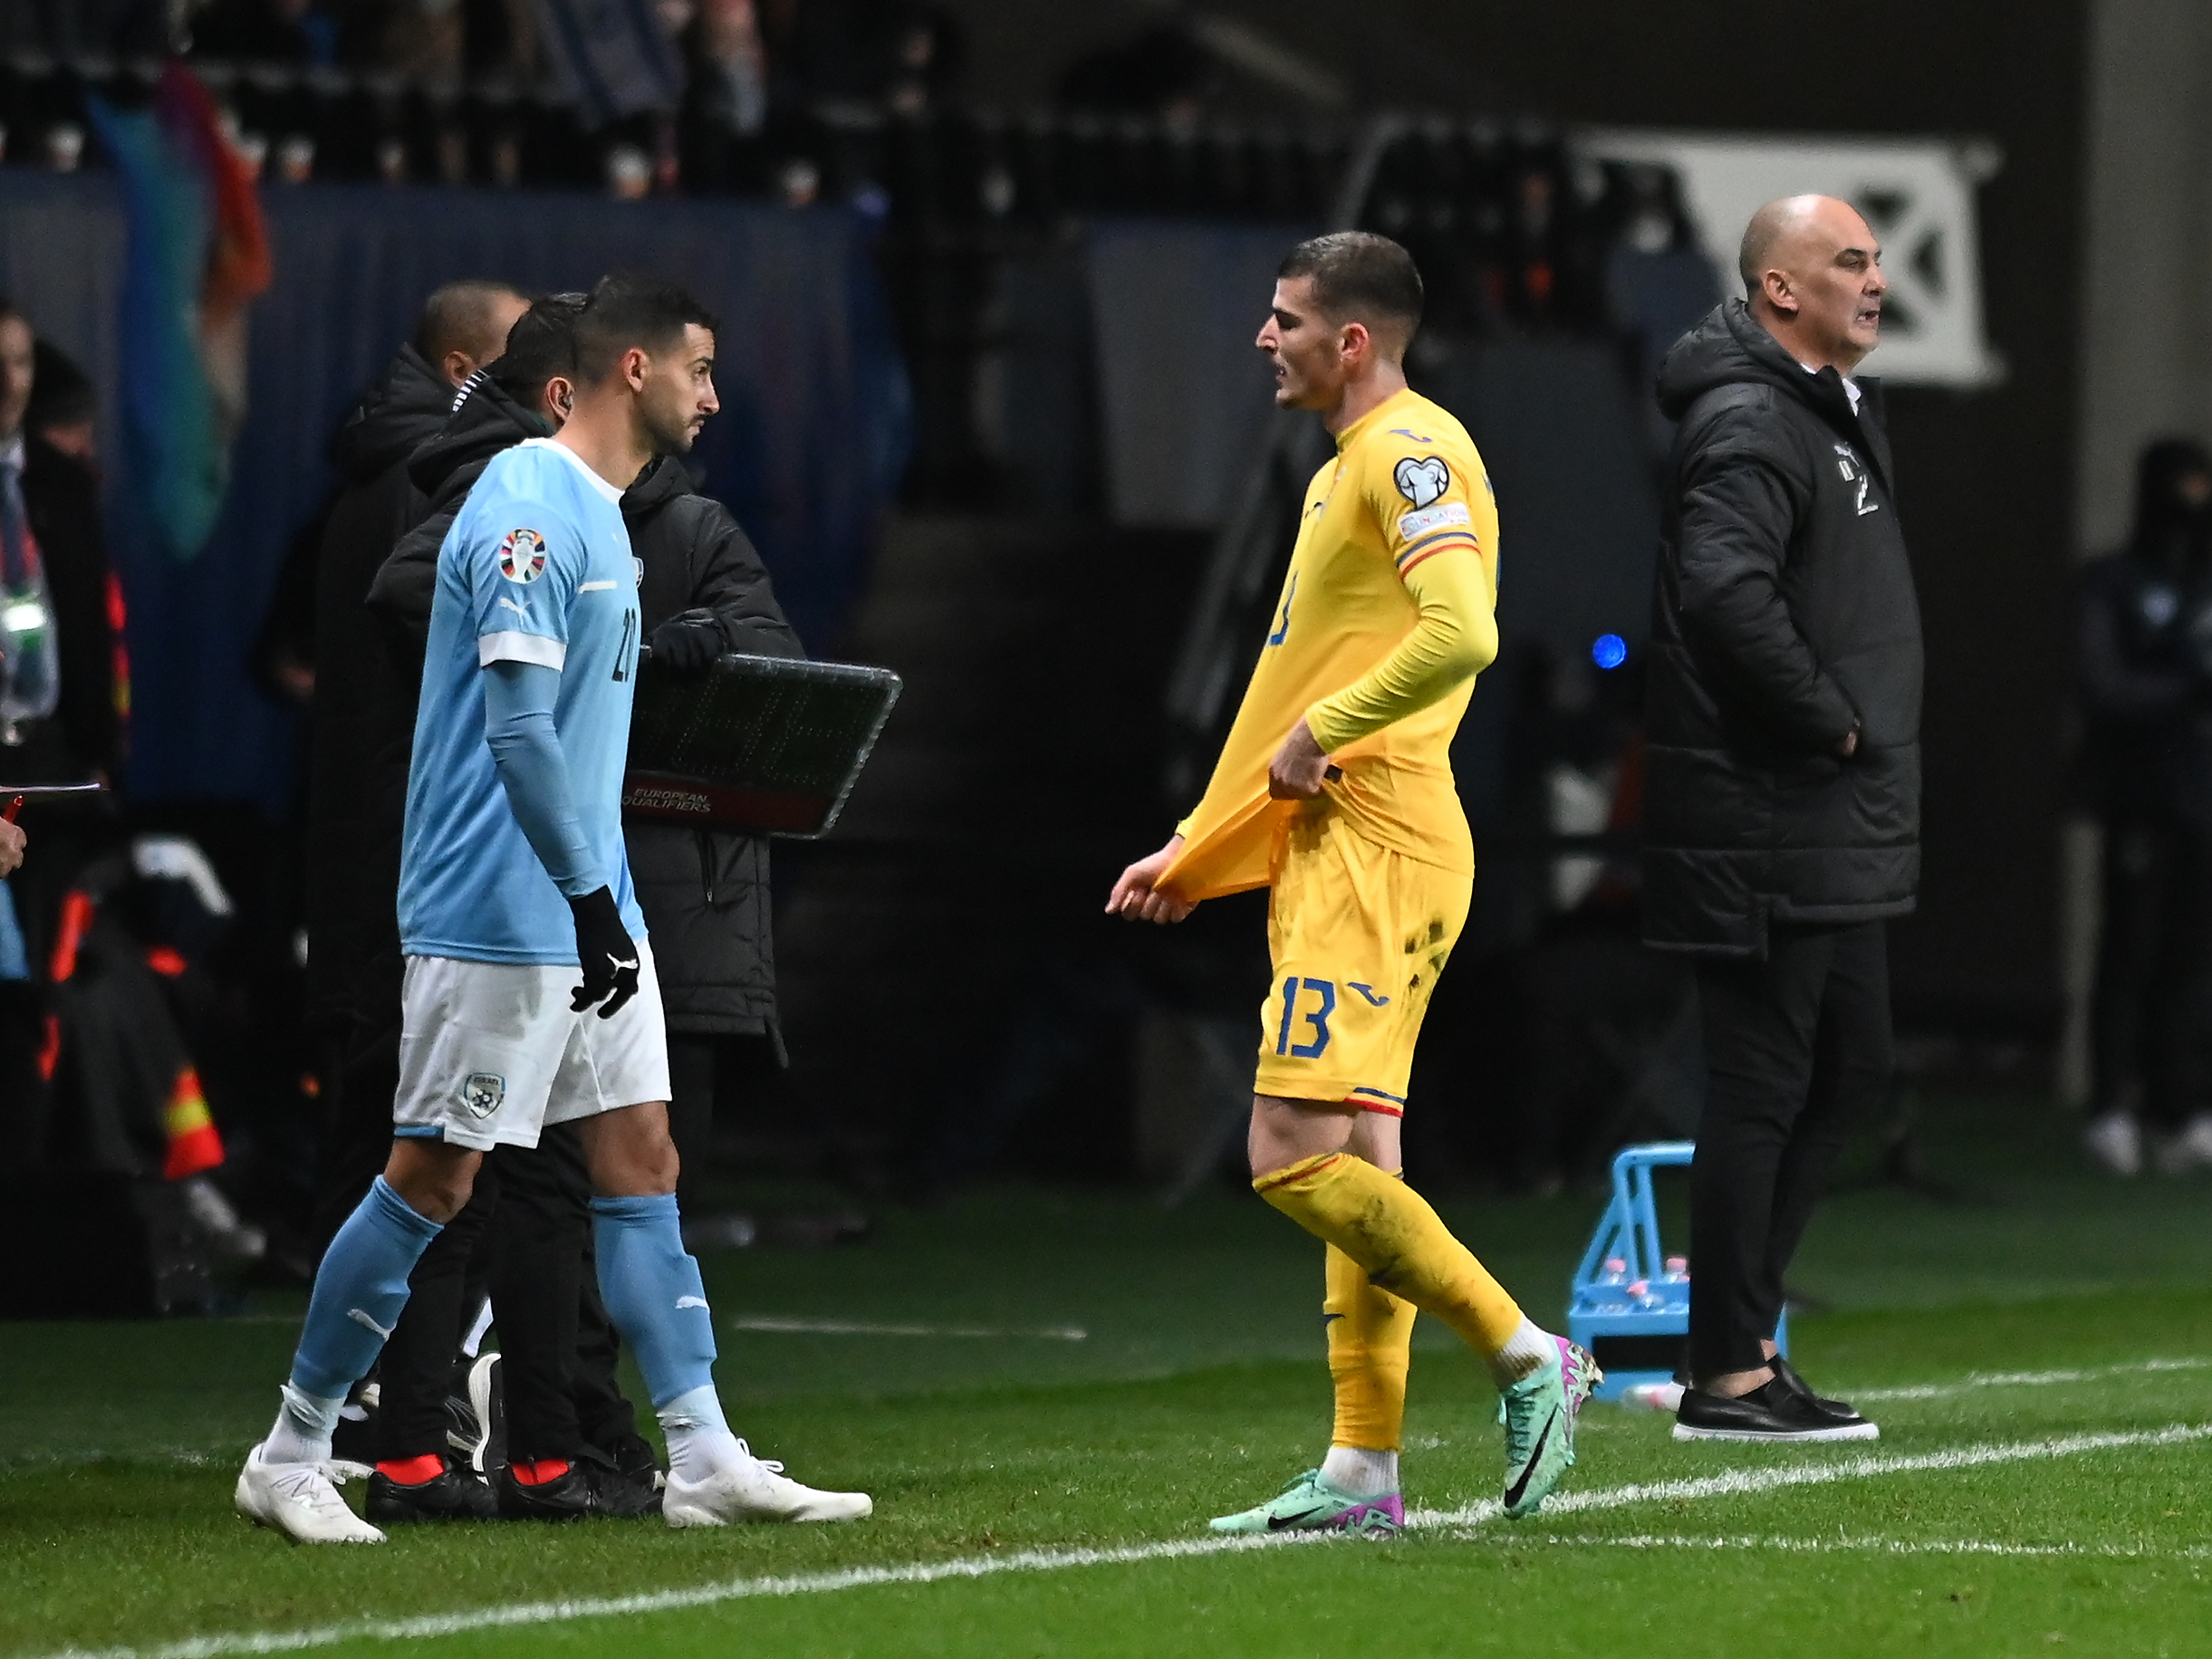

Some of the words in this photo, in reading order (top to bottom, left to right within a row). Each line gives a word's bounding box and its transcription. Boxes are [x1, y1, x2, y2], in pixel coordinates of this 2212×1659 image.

[634, 788, 708, 802] EUROPEAN
[621, 796, 711, 813] QUALIFIERS
[1275, 976, 1335, 1059] 13
